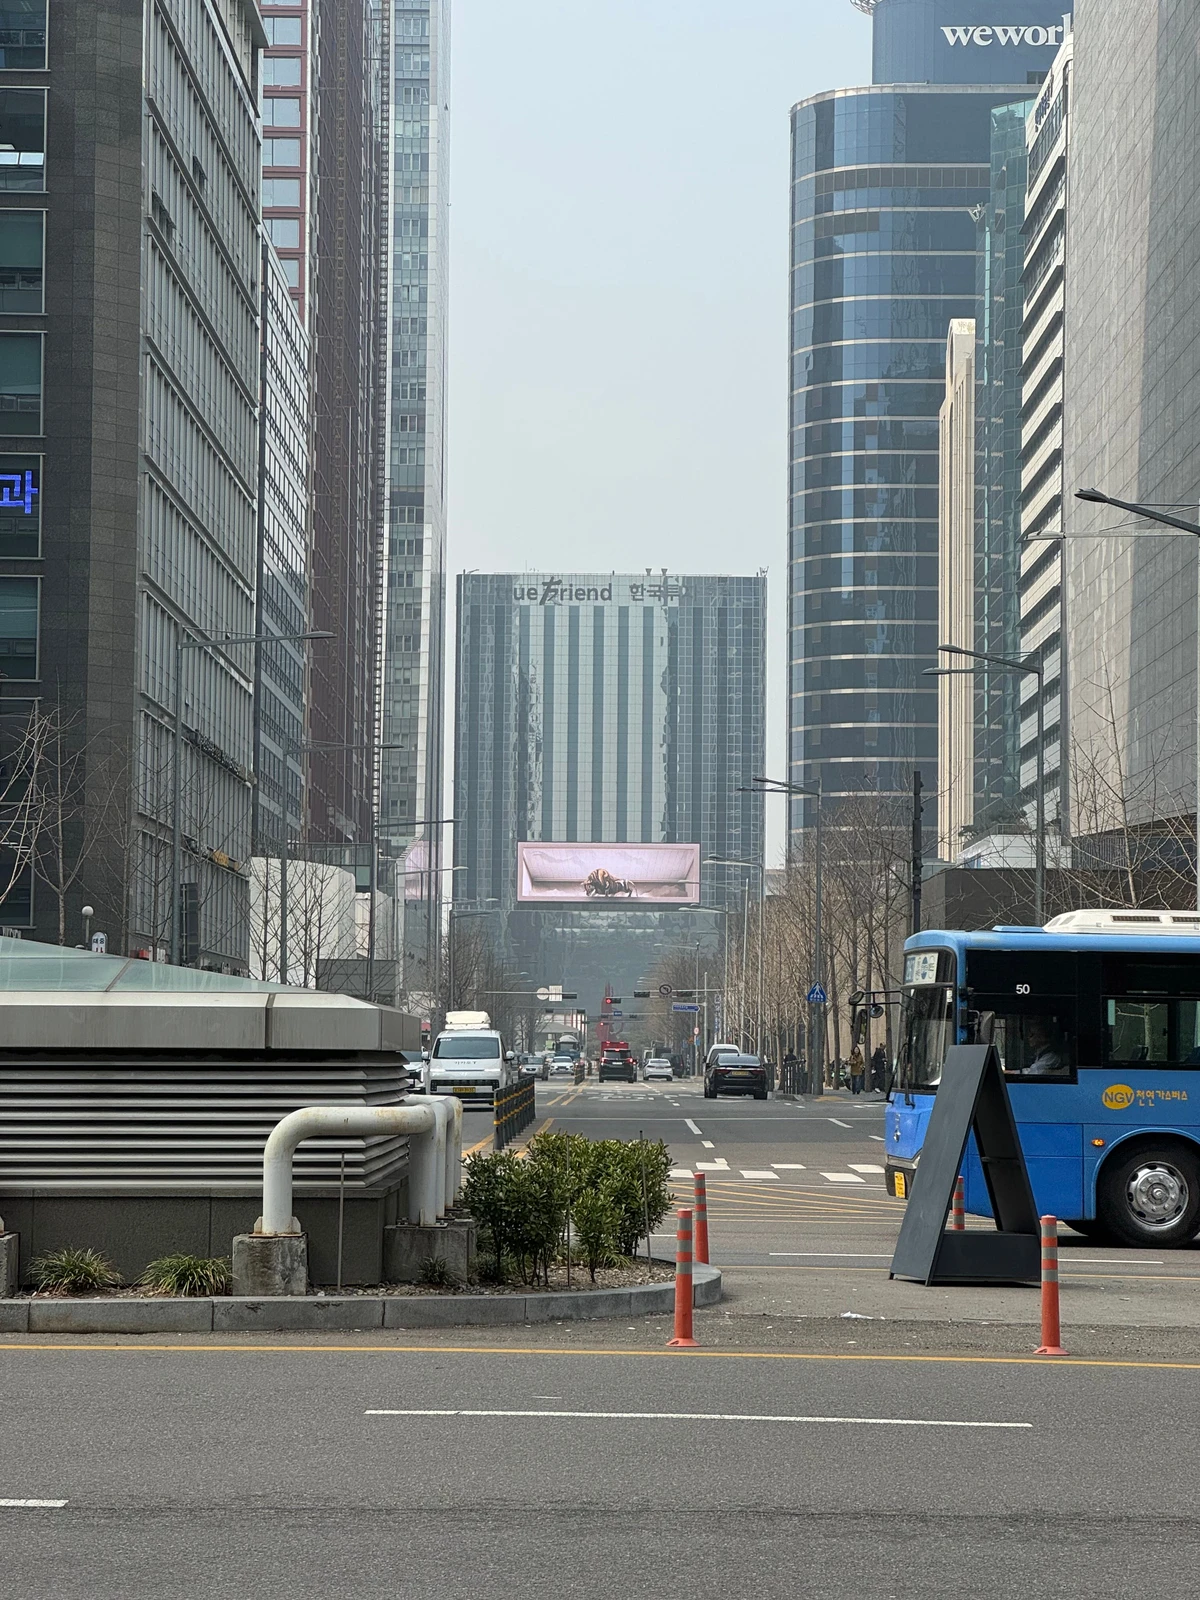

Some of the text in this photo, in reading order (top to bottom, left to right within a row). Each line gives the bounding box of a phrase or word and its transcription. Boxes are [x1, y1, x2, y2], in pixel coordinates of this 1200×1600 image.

[0, 470, 38, 514] 과
[1016, 983, 1030, 995] 50
[1104, 1090, 1188, 1107] NGV 천연가스버스
